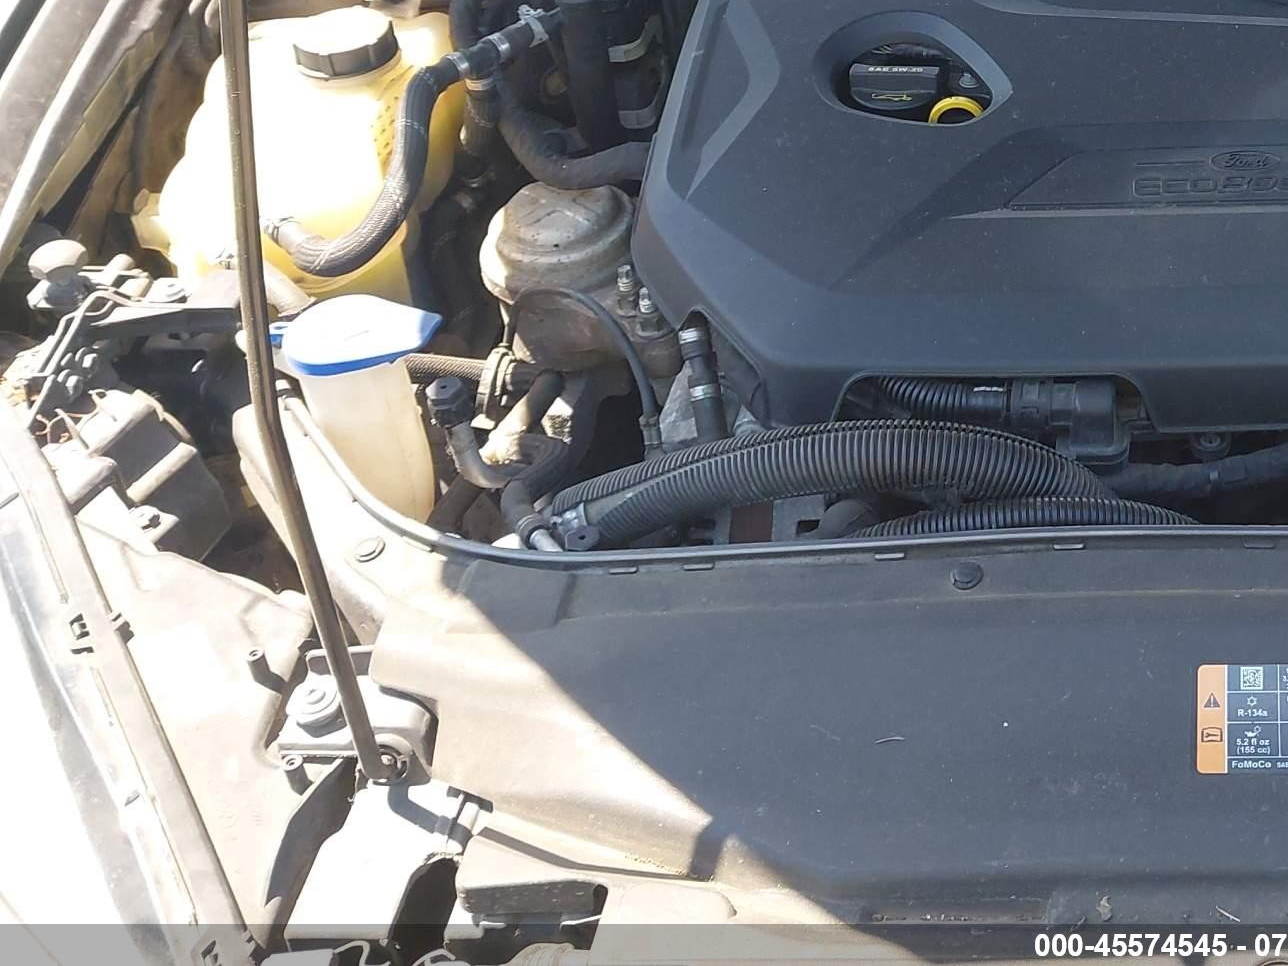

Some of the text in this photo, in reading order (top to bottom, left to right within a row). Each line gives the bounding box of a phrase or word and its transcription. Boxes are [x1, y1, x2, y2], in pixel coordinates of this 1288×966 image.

[1237, 708, 1268, 718] R-134a
[1236, 738, 1249, 746] 5.2
[1250, 738, 1258, 746] fl
[1236, 746, 1271, 755] (155 cc)
[1231, 760, 1272, 769] FoMoCo
